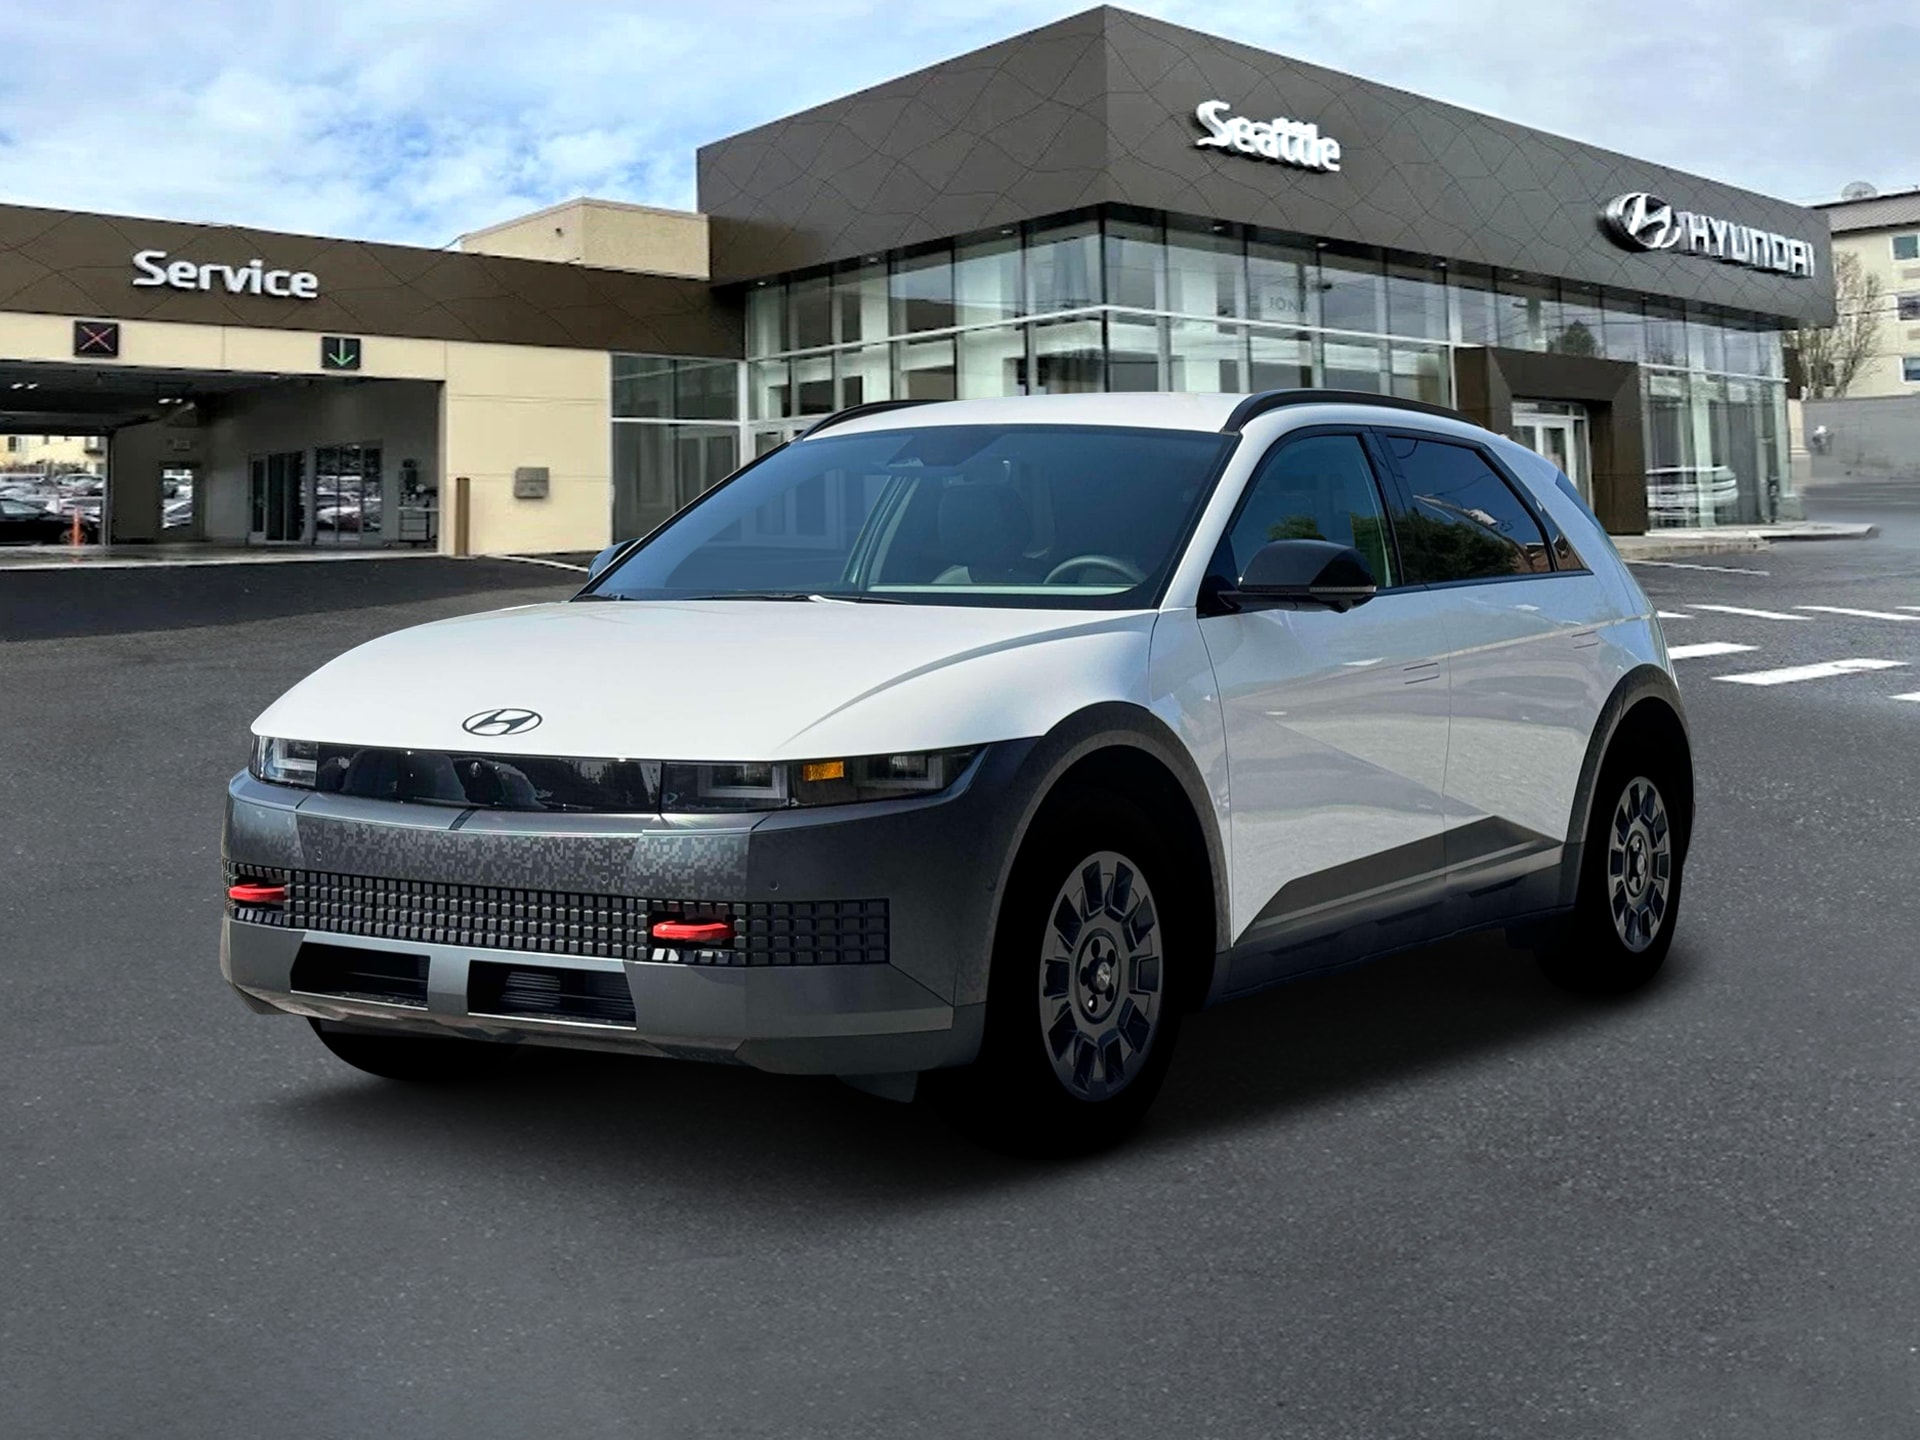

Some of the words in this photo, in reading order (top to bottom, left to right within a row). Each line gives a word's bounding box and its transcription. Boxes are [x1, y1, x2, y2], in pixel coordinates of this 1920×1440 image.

[1196, 100, 1341, 172] Seattle
[132, 250, 319, 299] Service
[1684, 213, 1814, 278] HYUNDAI
